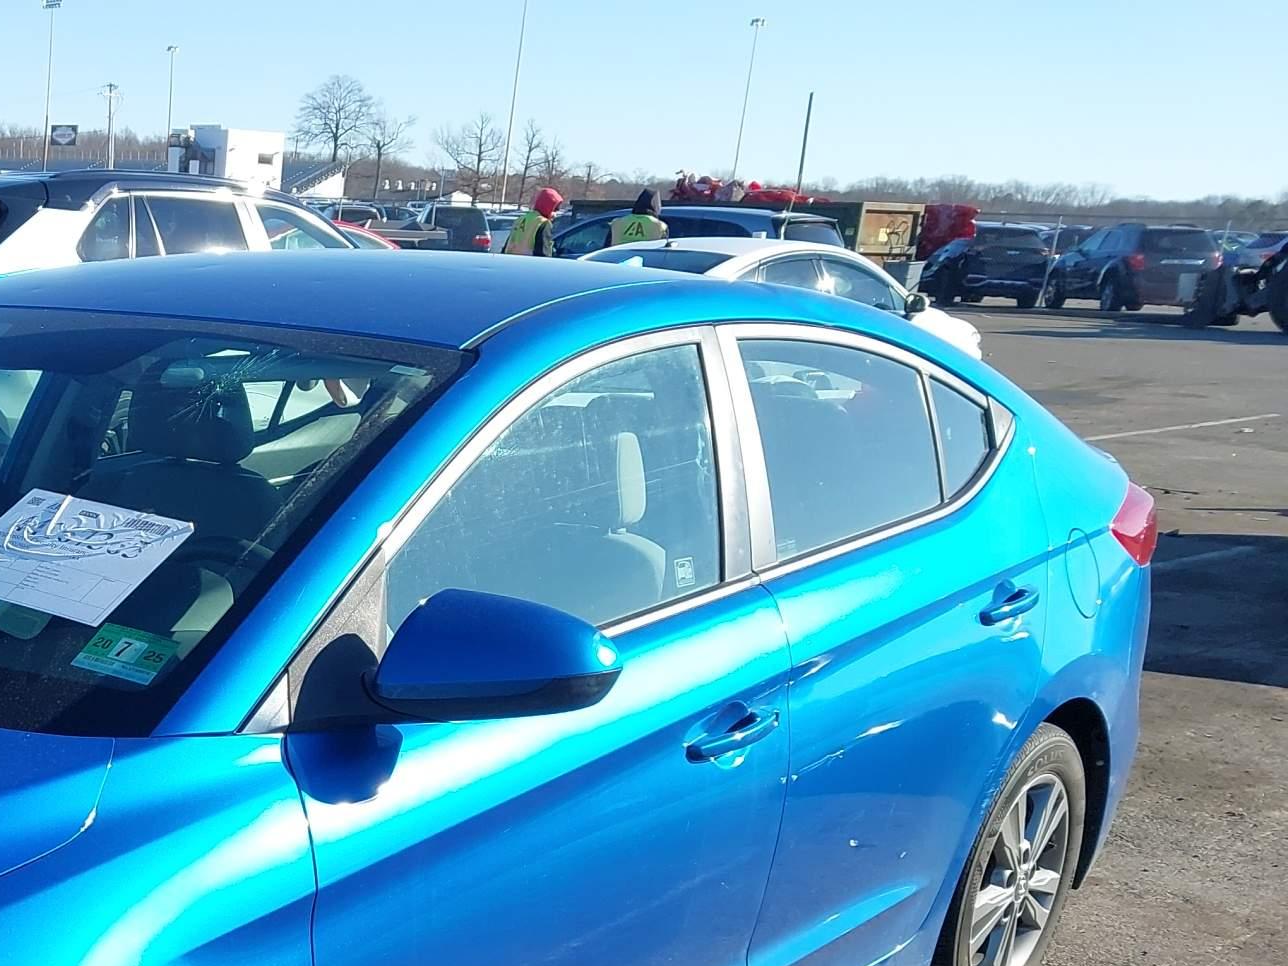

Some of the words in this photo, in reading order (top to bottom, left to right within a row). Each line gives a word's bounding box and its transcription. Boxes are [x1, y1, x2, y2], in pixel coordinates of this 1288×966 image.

[93, 636, 113, 649] 20
[115, 641, 134, 657] 7
[143, 650, 165, 664] 25
